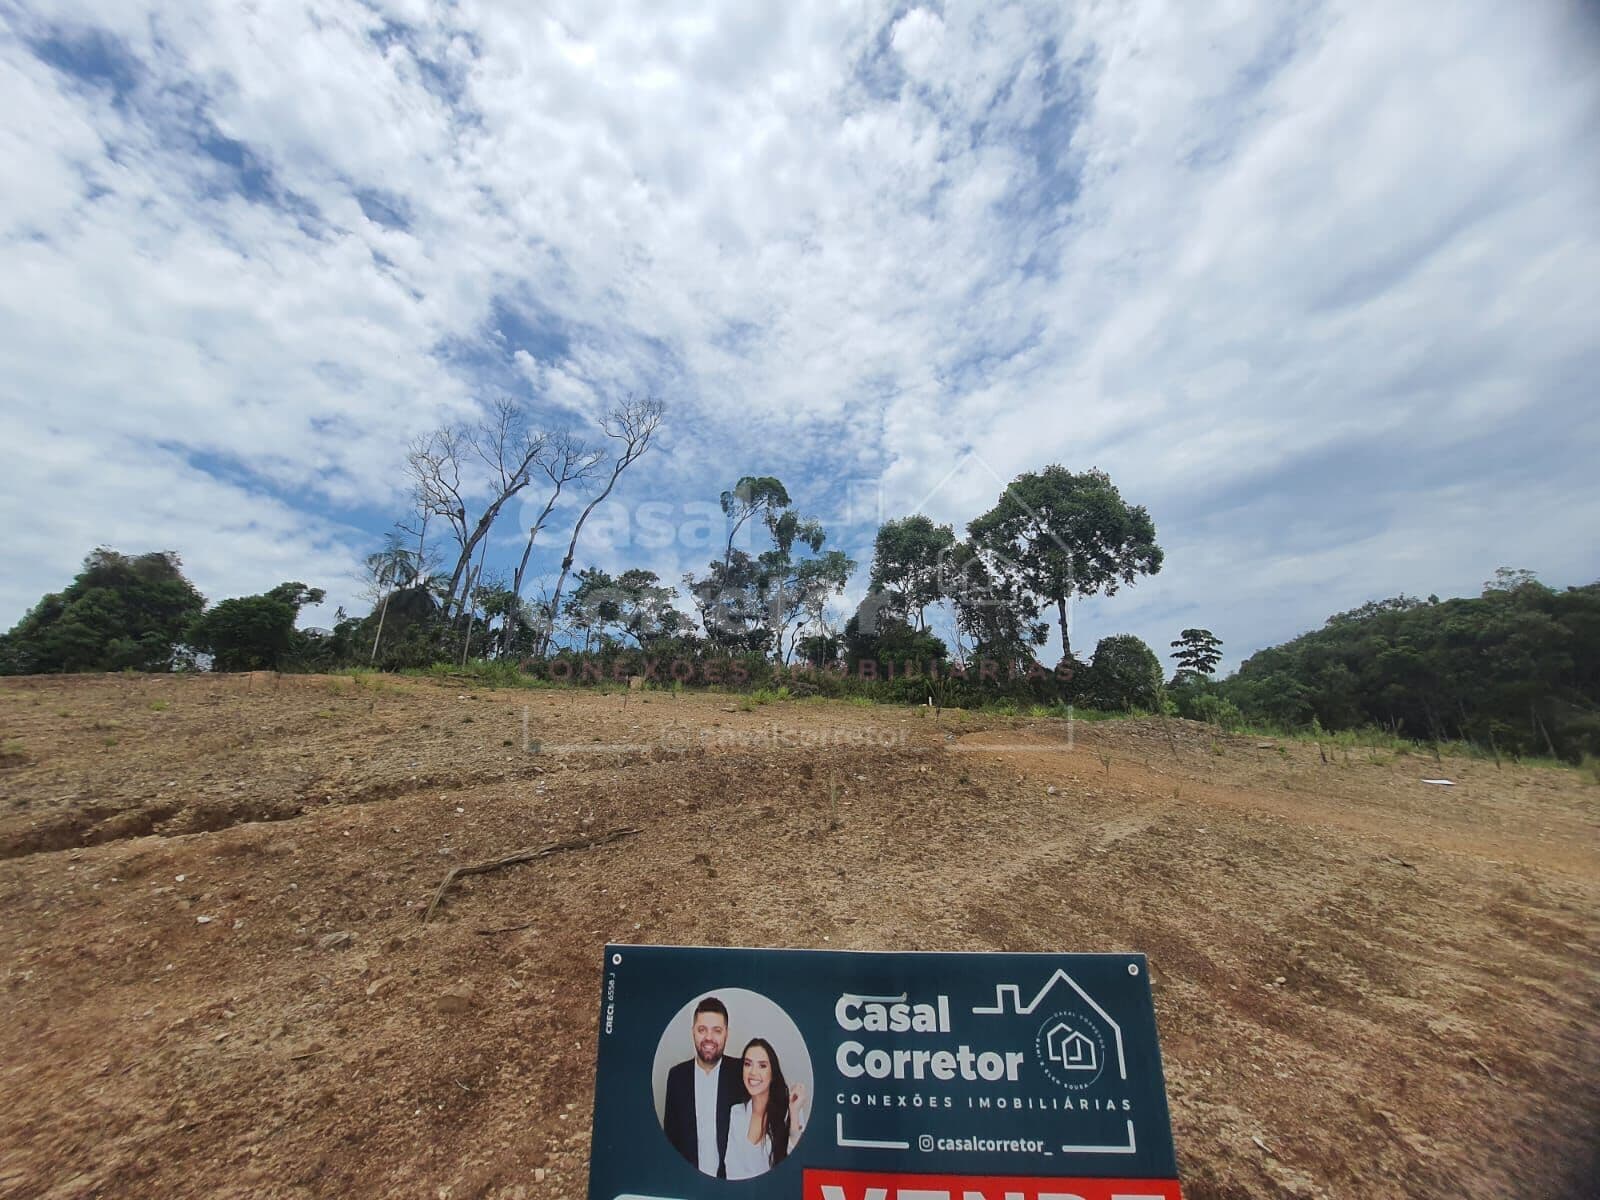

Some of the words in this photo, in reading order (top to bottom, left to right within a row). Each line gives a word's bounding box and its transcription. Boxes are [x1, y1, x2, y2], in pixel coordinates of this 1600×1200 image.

[834, 994, 951, 1032] Casal
[835, 1040, 1024, 1081] Corretor
[836, 1093, 952, 1108] CONEXÕES
[968, 1095, 1131, 1110] IMOBILIÁRIAS
